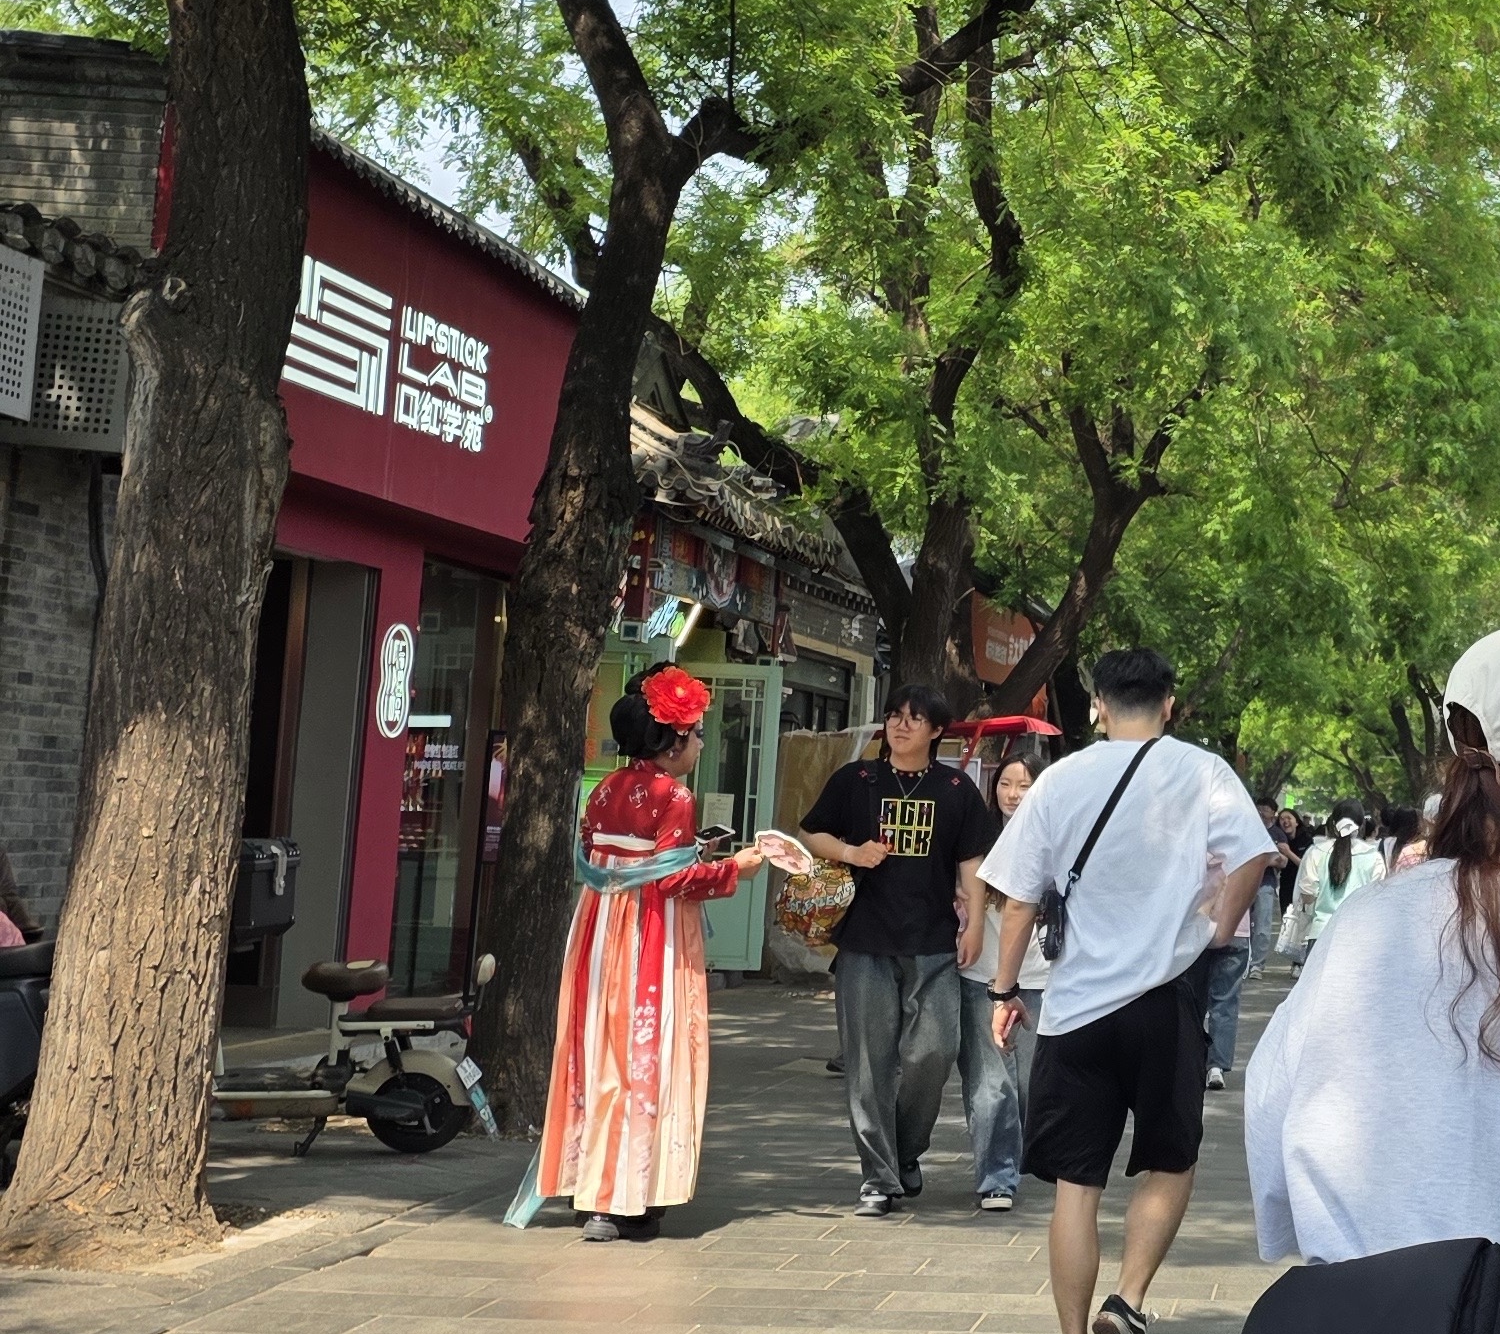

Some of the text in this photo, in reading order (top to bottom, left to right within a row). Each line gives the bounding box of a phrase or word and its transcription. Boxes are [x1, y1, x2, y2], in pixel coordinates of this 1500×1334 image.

[402, 305, 489, 373] LIPSTICK
[399, 342, 486, 407] LAB
[394, 383, 484, 452] 口红学苑
